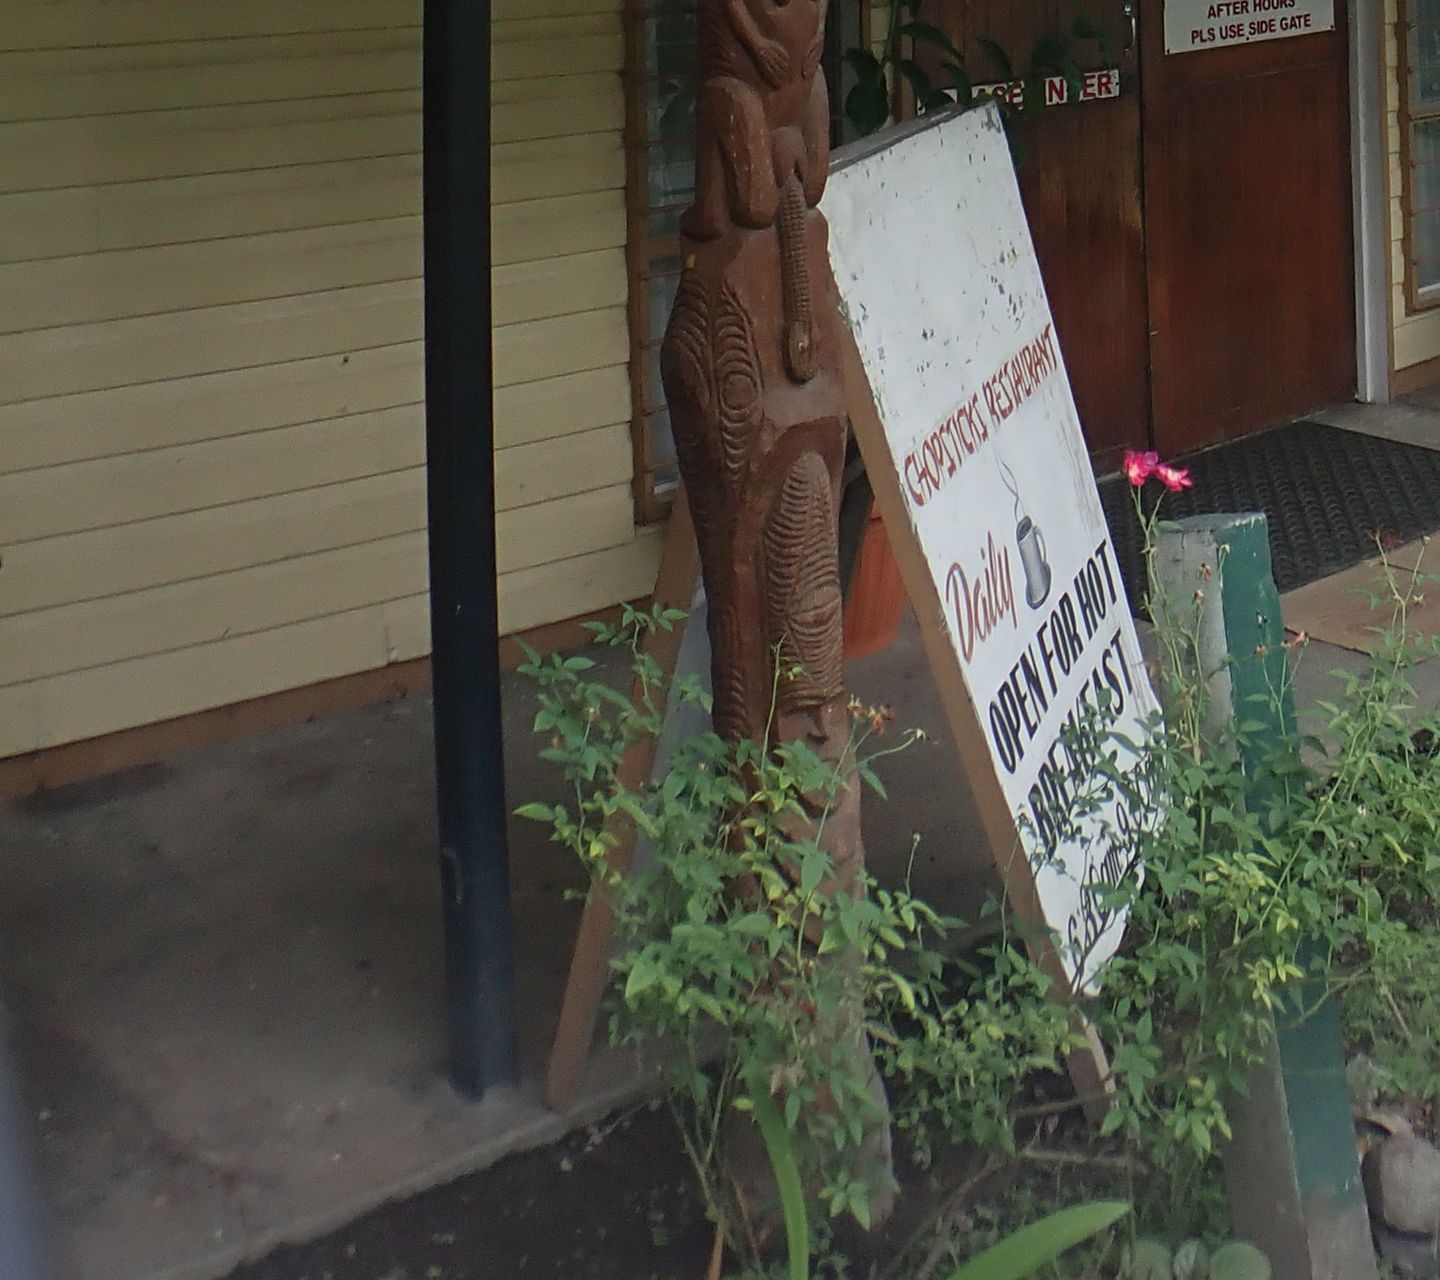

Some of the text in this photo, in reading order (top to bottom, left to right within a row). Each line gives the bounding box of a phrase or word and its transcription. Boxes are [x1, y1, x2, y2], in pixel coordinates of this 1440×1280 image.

[1191, 14, 1311, 45] PLS USE SIDE GATE
[1207, 0, 1249, 19] AFTER
[904, 323, 1057, 507] CHOPSTICKS RESTAURANT
[946, 531, 1018, 664] Daily
[989, 538, 1117, 775] OPEN FOR HOT
